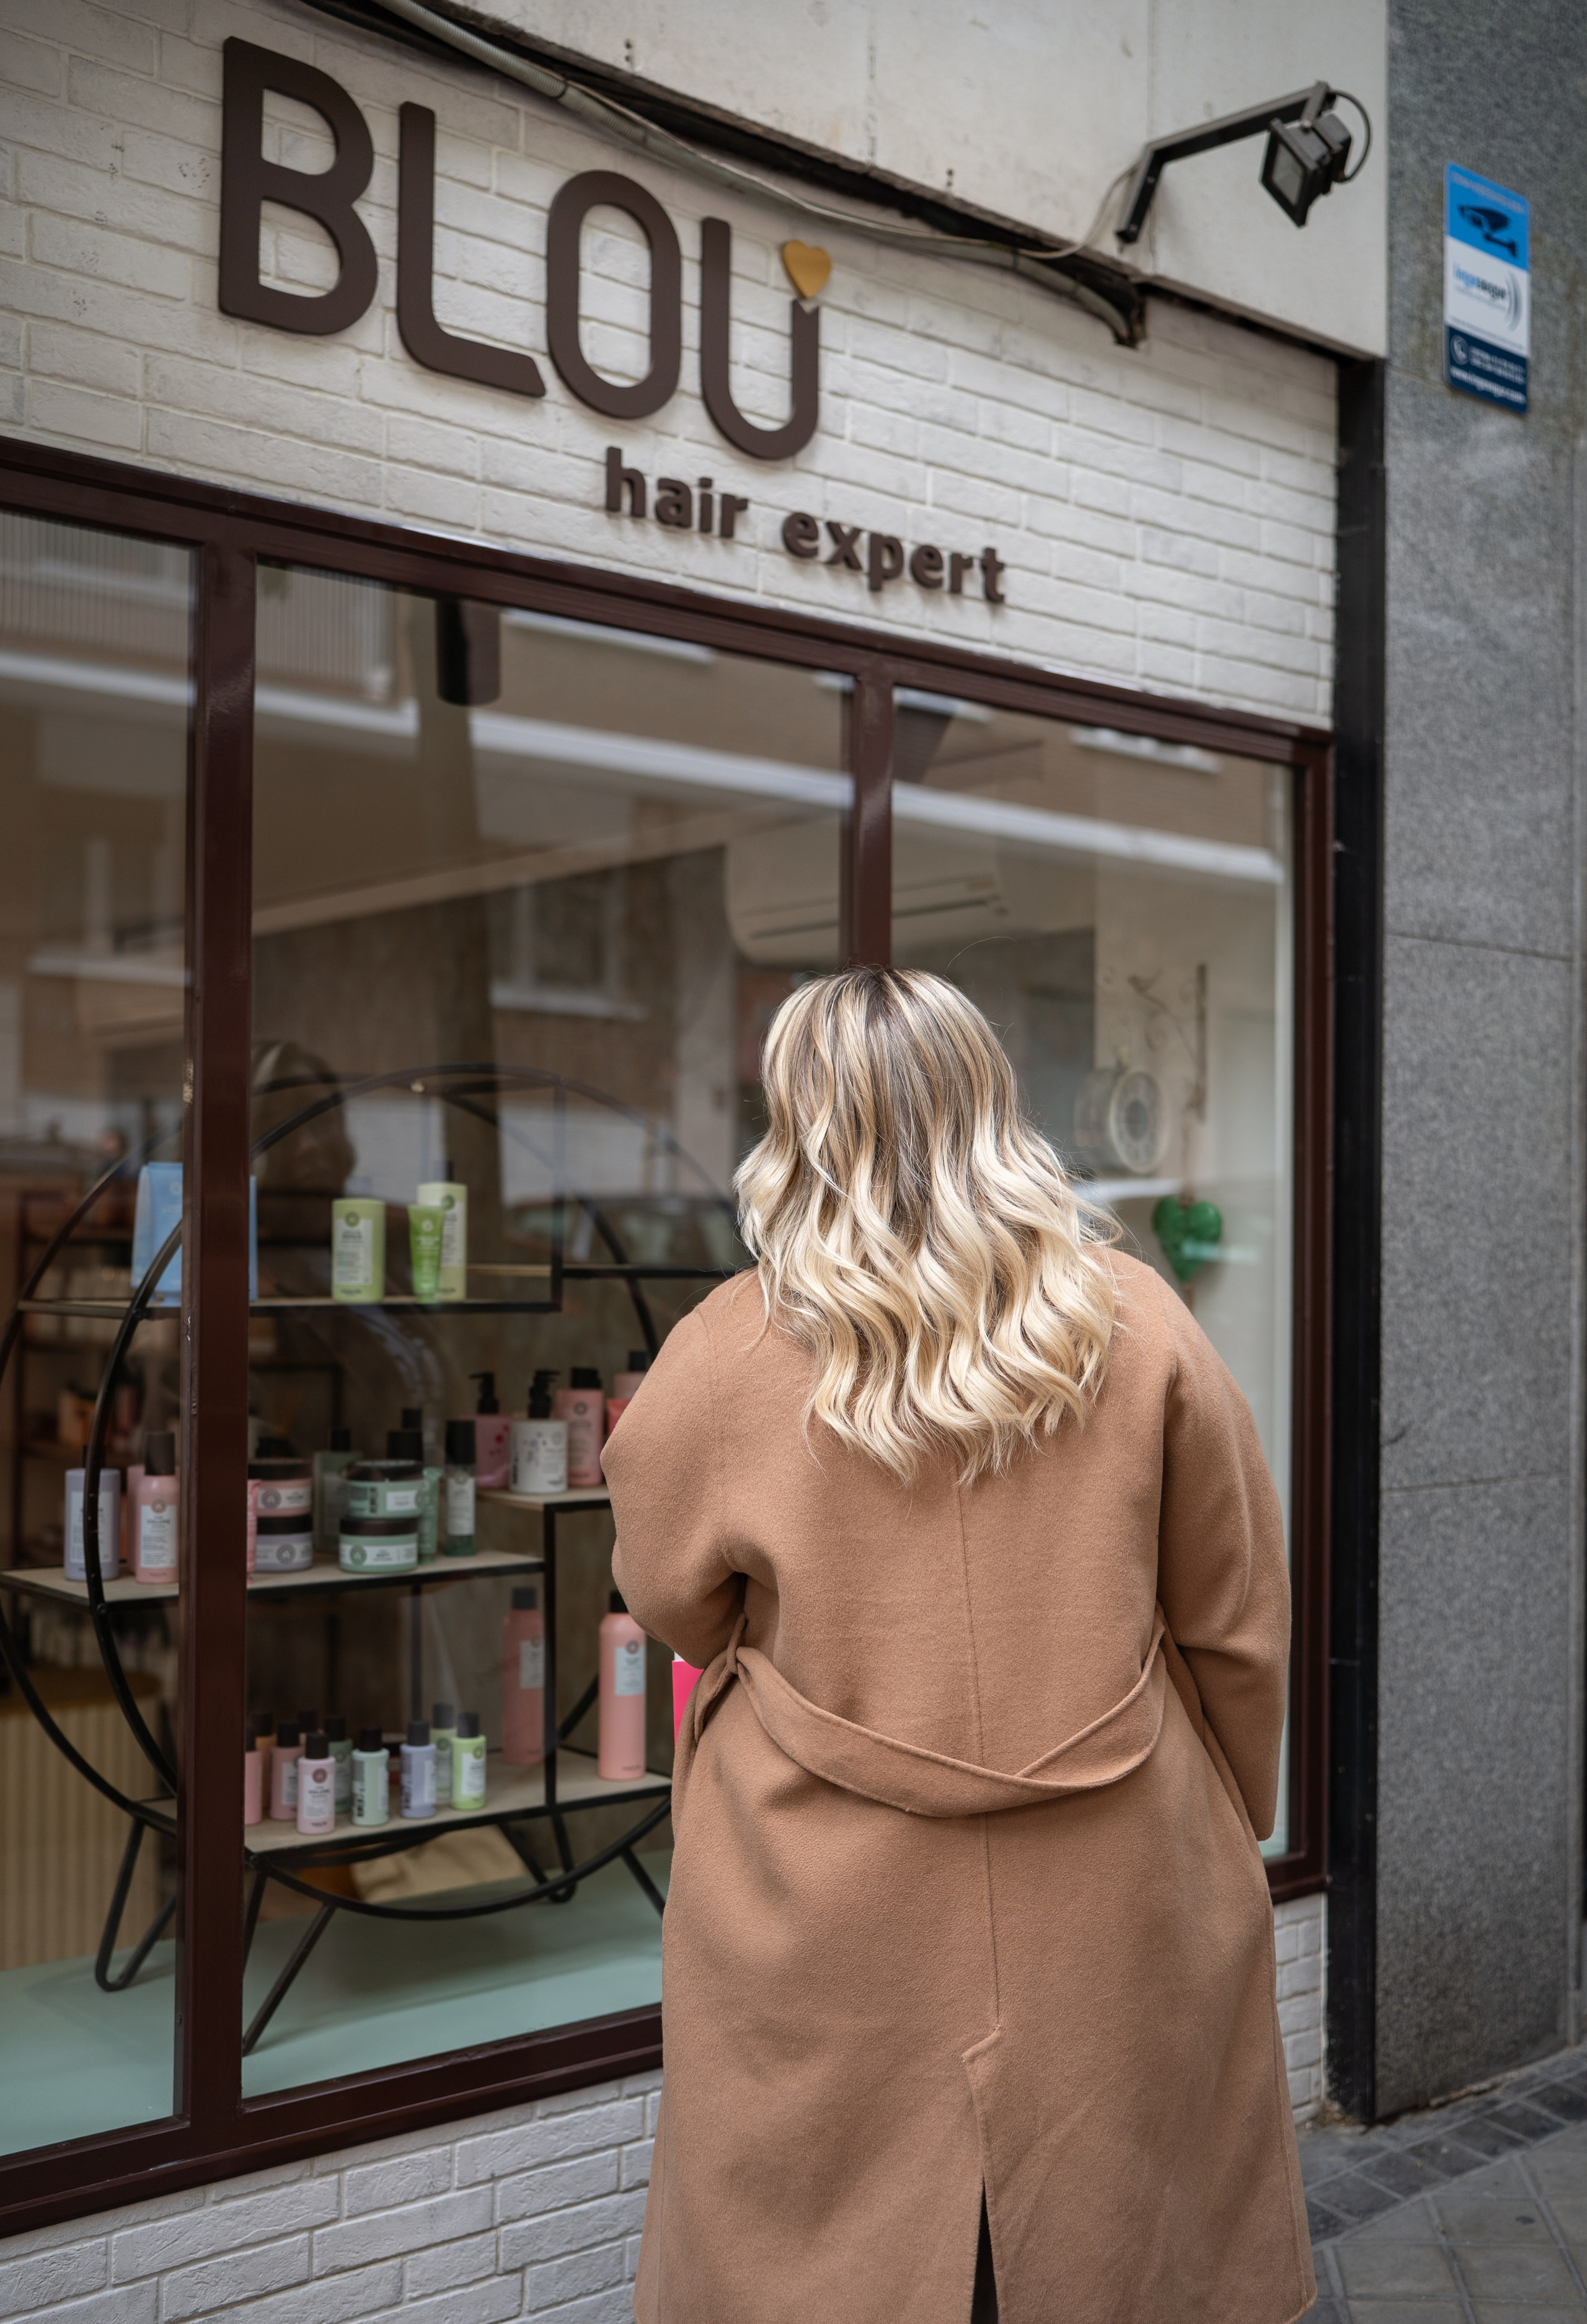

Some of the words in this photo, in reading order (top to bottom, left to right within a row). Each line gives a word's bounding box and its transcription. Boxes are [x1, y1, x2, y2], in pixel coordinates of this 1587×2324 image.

[218, 36, 820, 461] BLOU
[605, 446, 748, 538] hair
[782, 512, 1005, 603] expert
